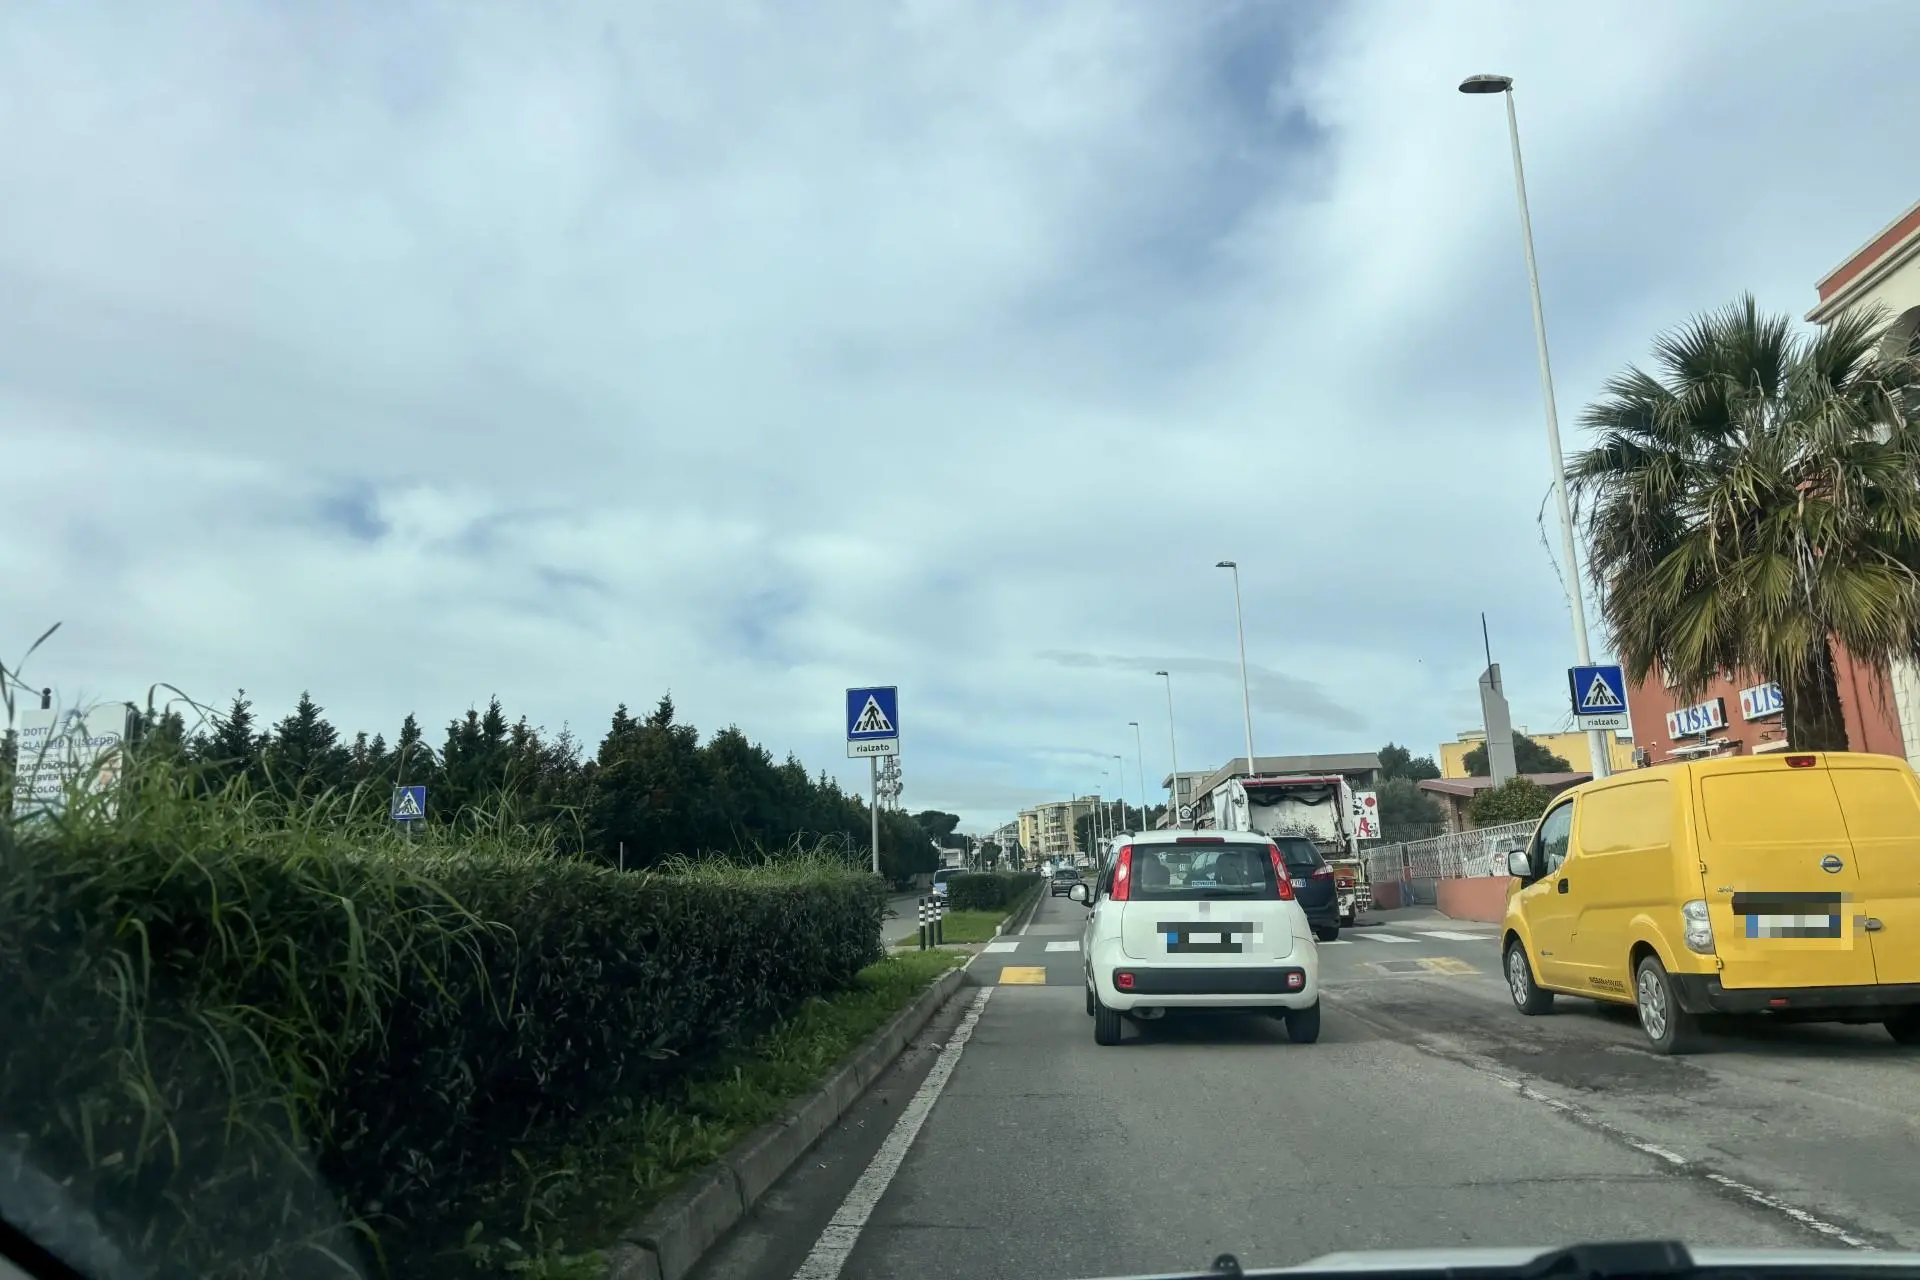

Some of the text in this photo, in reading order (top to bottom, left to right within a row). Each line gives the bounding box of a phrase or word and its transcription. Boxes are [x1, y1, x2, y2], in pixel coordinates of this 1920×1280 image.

[1751, 685, 1784, 713] LIS
[1587, 718, 1620, 726] rialzato
[1675, 706, 1712, 734] LISA
[23, 727, 48, 736] DOTT
[857, 744, 890, 752] rialzato
